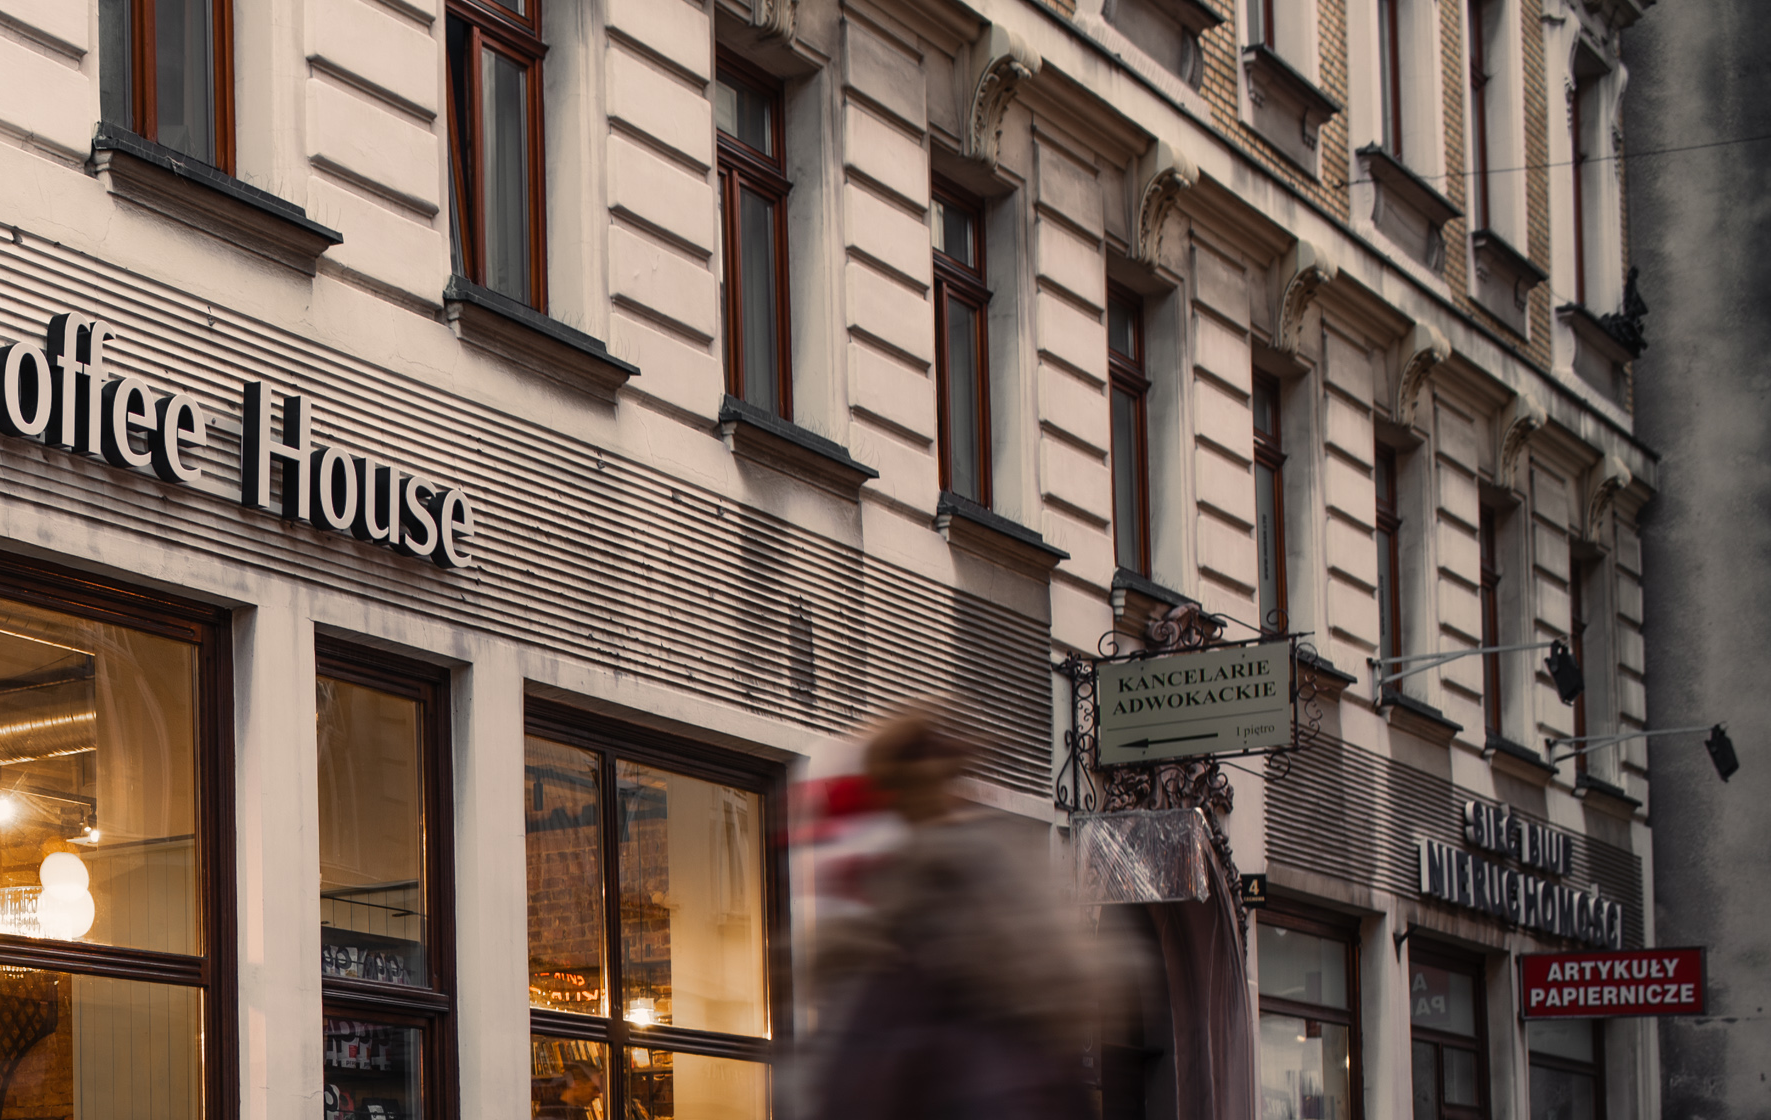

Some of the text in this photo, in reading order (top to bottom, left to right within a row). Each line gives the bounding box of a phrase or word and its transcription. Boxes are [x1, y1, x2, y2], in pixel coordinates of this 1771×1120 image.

[242, 381, 475, 569] House
[1118, 659, 1271, 693] KANCELARIE
[1112, 681, 1277, 716] ADWOKACKIE
[1243, 723, 1275, 738] piętro
[1249, 879, 1260, 896] 4
[1419, 837, 1622, 950] NIERUCHOMOŚCI
[1547, 958, 1680, 982] ARTYKUŁY
[1530, 984, 1695, 1008] PAPIERNICZE
